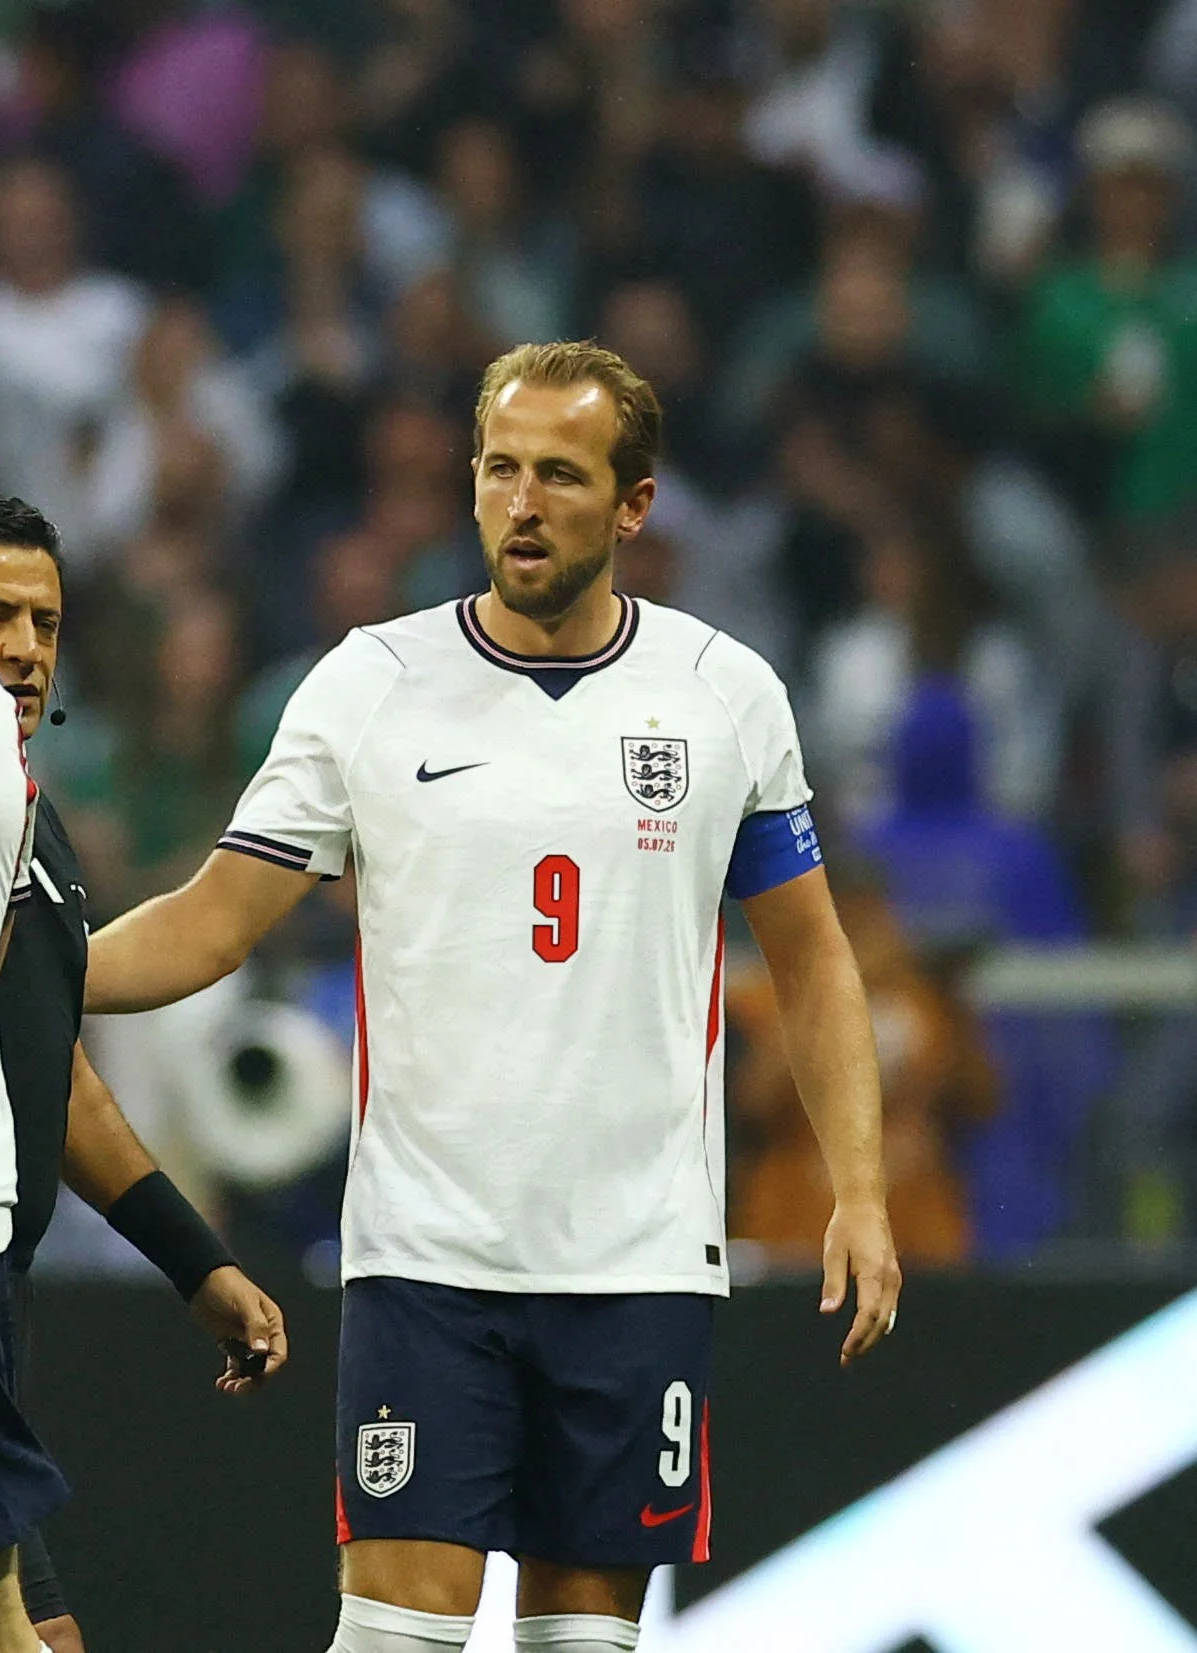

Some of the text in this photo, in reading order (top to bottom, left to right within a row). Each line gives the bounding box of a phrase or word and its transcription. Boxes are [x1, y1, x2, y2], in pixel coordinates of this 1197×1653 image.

[637, 819, 678, 833] MEXICO
[637, 838, 675, 852] 05.07.26
[532, 855, 580, 962] 9
[659, 1381, 692, 1487] 9
